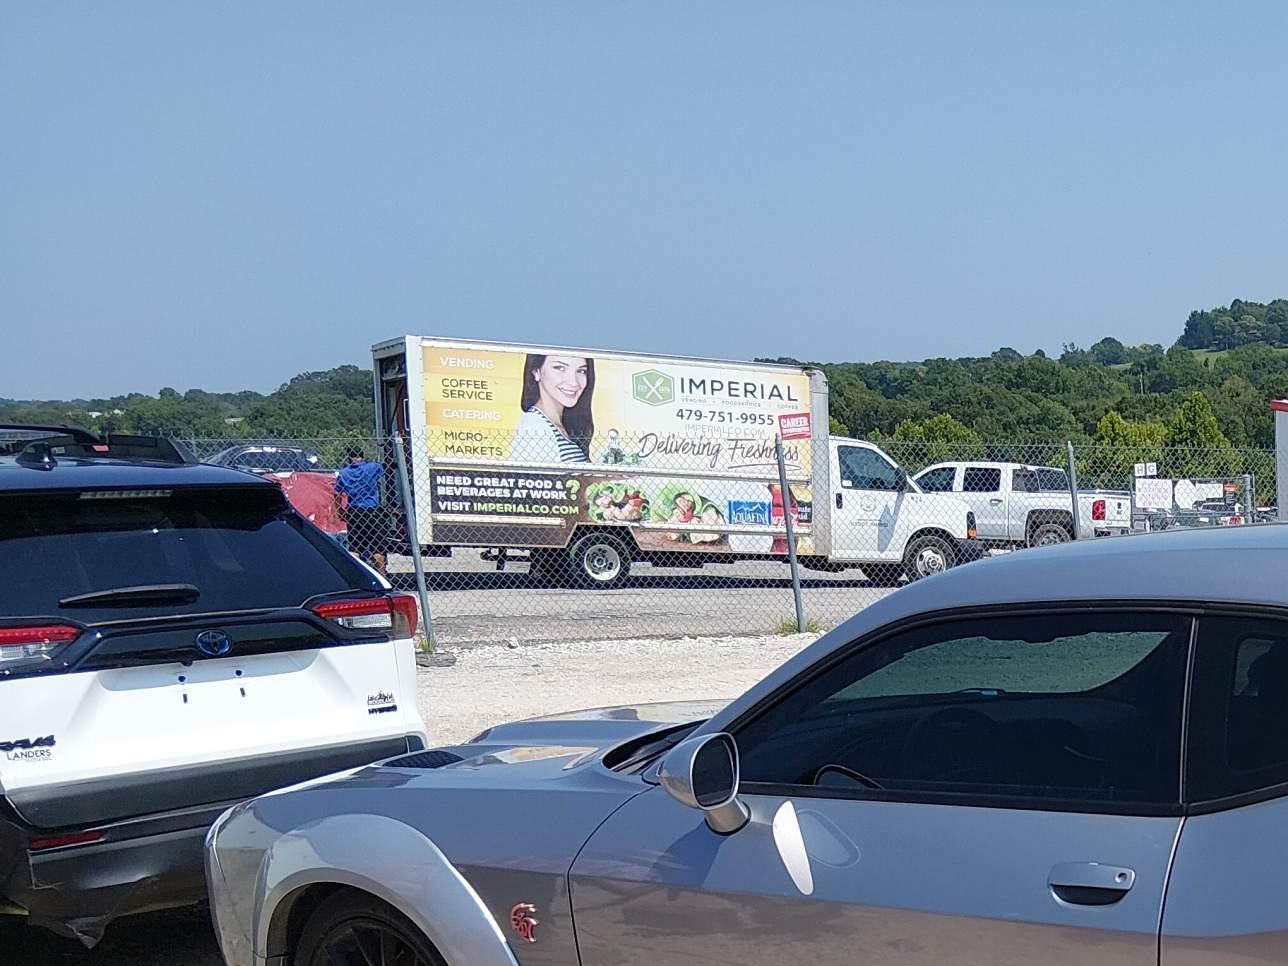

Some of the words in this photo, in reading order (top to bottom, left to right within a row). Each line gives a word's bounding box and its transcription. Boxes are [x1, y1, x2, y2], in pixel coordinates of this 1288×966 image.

[440, 356, 494, 368] VENDING
[441, 378, 488, 390] COFFEE
[680, 377, 798, 402] IMPERIAL
[442, 389, 493, 400] SERVICE
[442, 408, 500, 420] CATERING
[676, 408, 774, 426] 479-751-9955
[444, 431, 488, 442] MICRO-
[445, 444, 503, 456] MARKETS
[638, 433, 721, 468] Delivering
[728, 438, 798, 463] Freshnss
[436, 476, 472, 486] NEED
[474, 477, 516, 488] GREAT
[518, 478, 552, 489] FOOD
[556, 480, 564, 489] &
[437, 486, 510, 498] BEVERAGES
[512, 489, 528, 498] AT
[529, 490, 568, 500] WORK
[438, 500, 471, 511] VISIT
[473, 502, 580, 514] IMPERIALCO.COM
[6, 749, 52, 761] LANDERS
